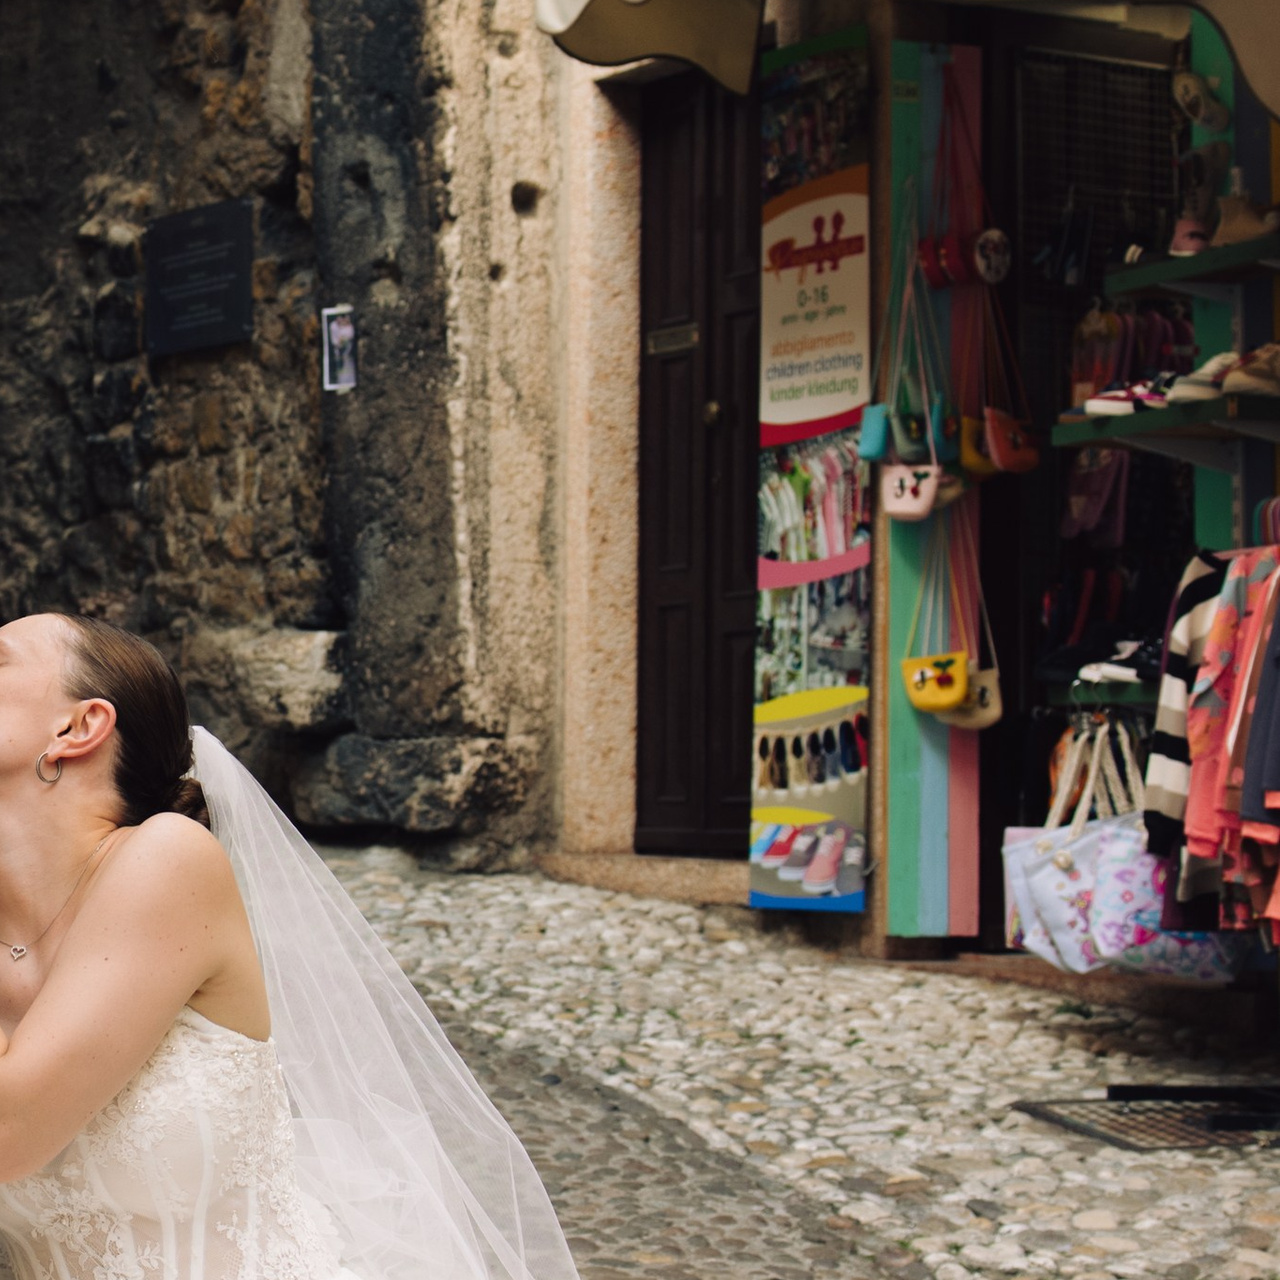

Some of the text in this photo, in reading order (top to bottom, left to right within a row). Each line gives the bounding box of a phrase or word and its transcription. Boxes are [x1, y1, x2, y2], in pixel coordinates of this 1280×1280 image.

[797, 285, 829, 308] 0-16
[771, 331, 855, 358] abbigliamento
[767, 353, 863, 382] children clothing
